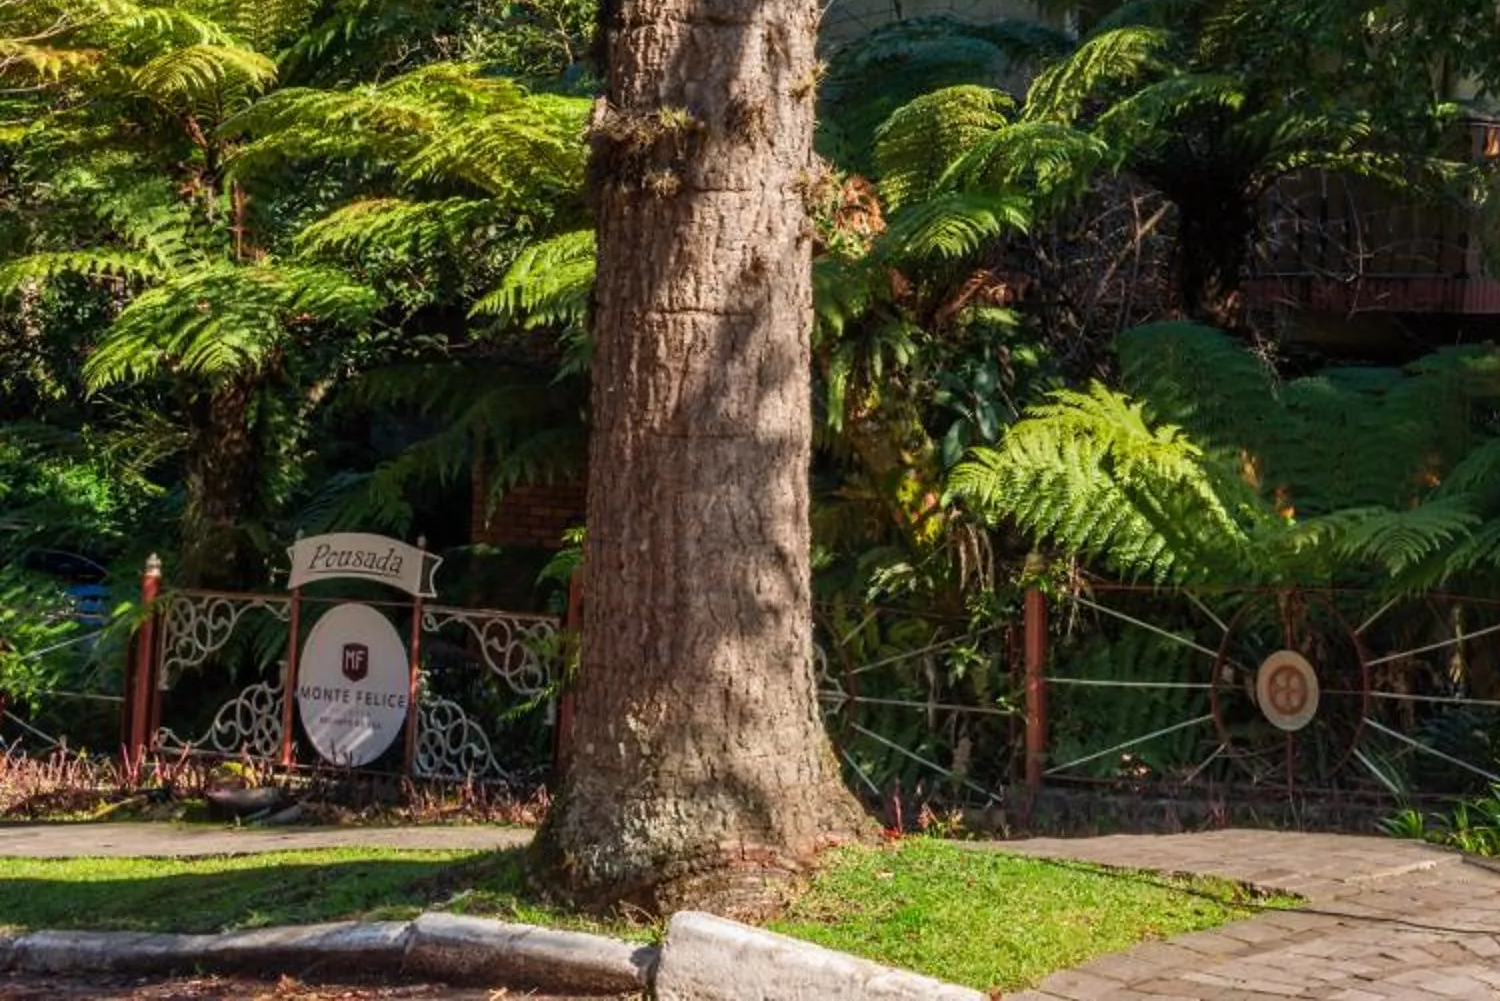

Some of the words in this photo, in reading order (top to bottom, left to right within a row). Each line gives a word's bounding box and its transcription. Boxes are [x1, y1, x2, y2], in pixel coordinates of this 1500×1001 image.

[308, 543, 404, 575] Pousada
[345, 649, 366, 670] MF
[300, 686, 350, 704] MONTE
[356, 690, 407, 709] FELICE
